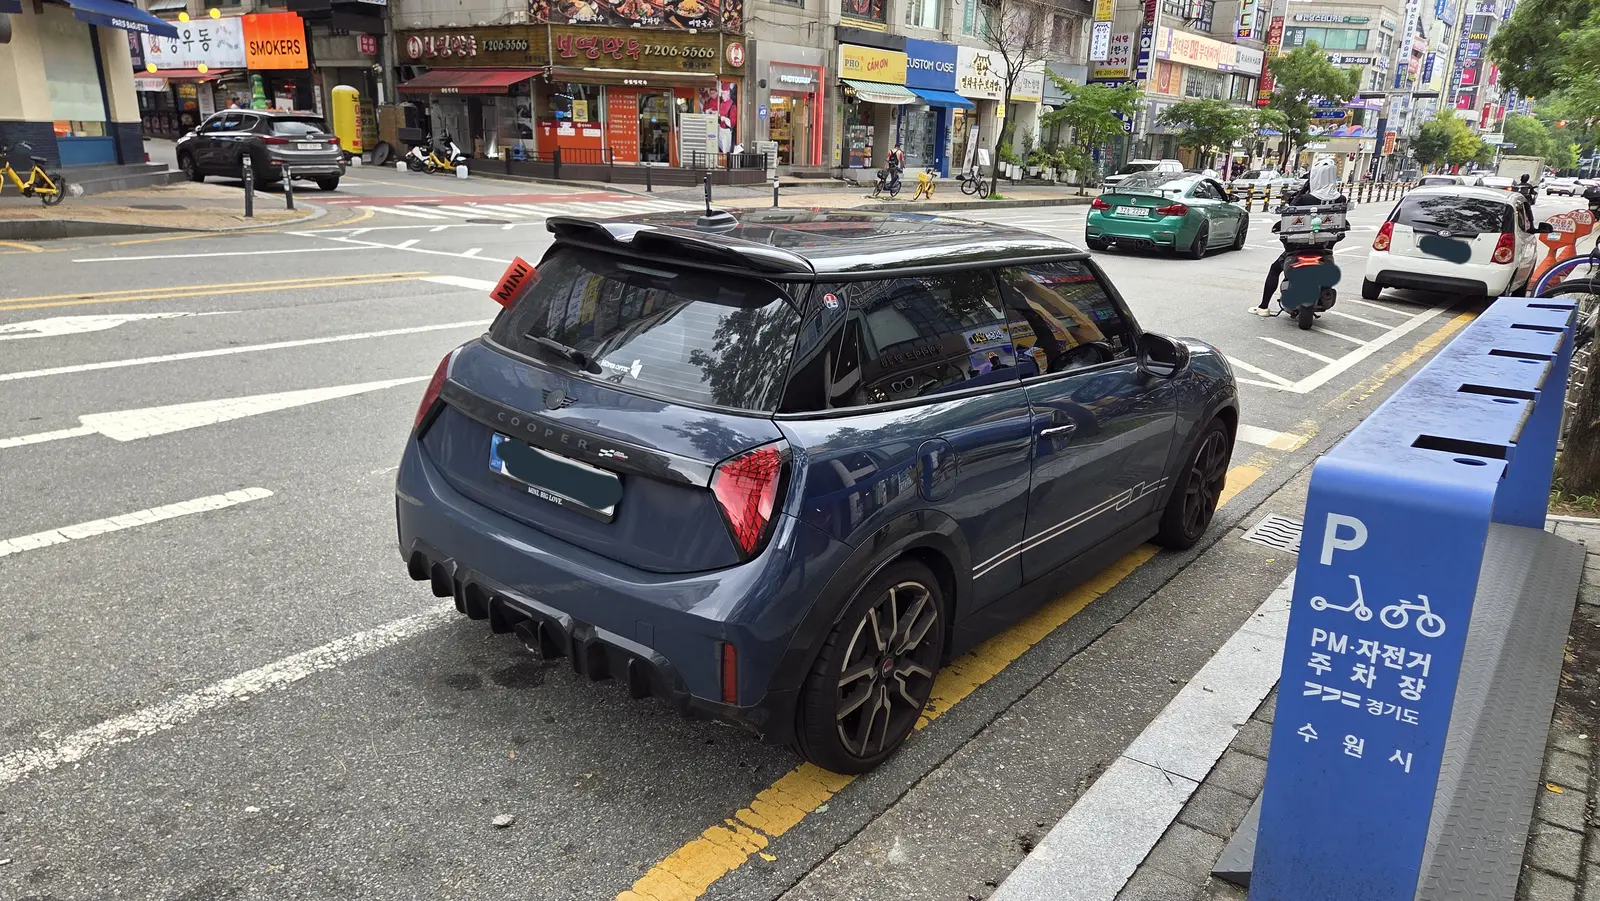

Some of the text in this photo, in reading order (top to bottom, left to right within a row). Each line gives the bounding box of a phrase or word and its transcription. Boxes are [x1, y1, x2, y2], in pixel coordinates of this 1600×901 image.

[112, 18, 149, 32] PARIS BAGUETTE
[250, 39, 301, 56] SMOKERS
[556, 34, 641, 60] 보영만두
[844, 58, 860, 68] PHO
[935, 61, 955, 73] CASE
[497, 263, 529, 302] MINI
[497, 412, 589, 450] COOPER
[1320, 512, 1368, 566] P
[1366, 698, 1420, 726] 경기도
